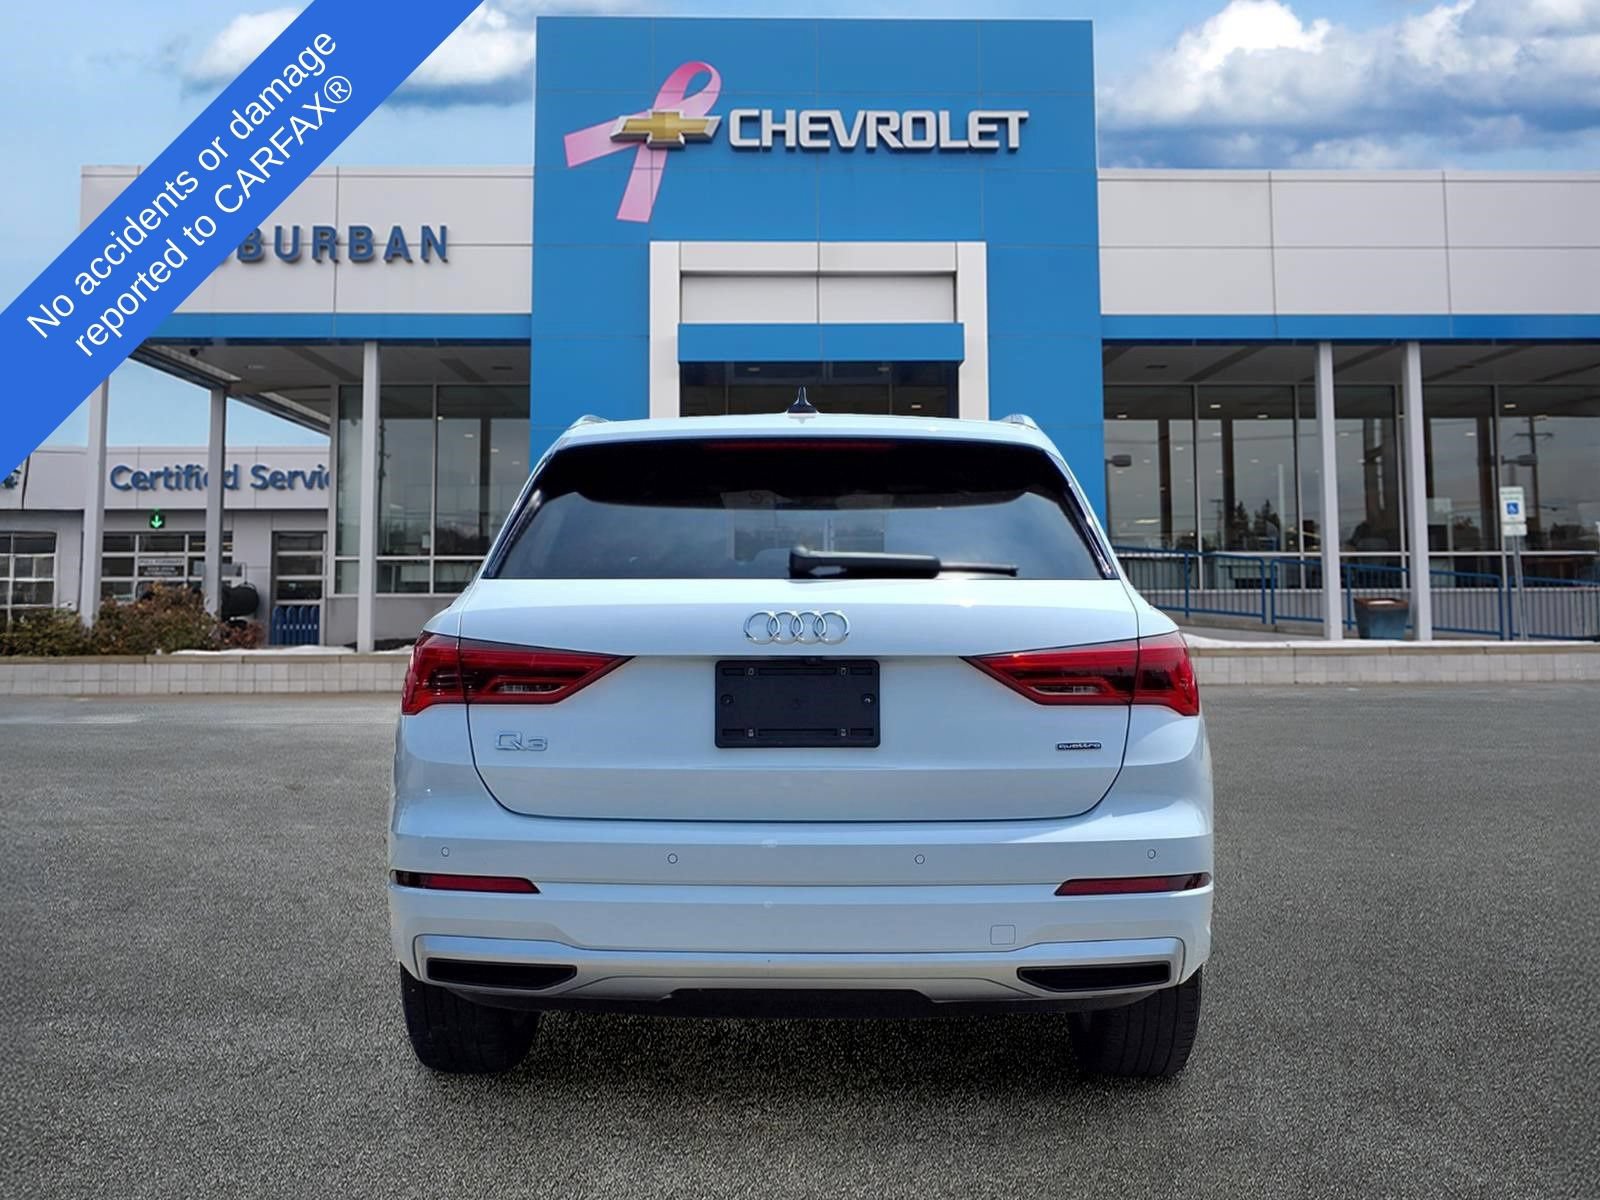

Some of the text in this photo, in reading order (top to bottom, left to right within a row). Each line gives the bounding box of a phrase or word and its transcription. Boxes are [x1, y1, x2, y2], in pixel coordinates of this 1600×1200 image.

[729, 108, 1029, 152] CHEVROLET
[222, 224, 450, 263] BURBAN
[495, 731, 548, 751] Q3
